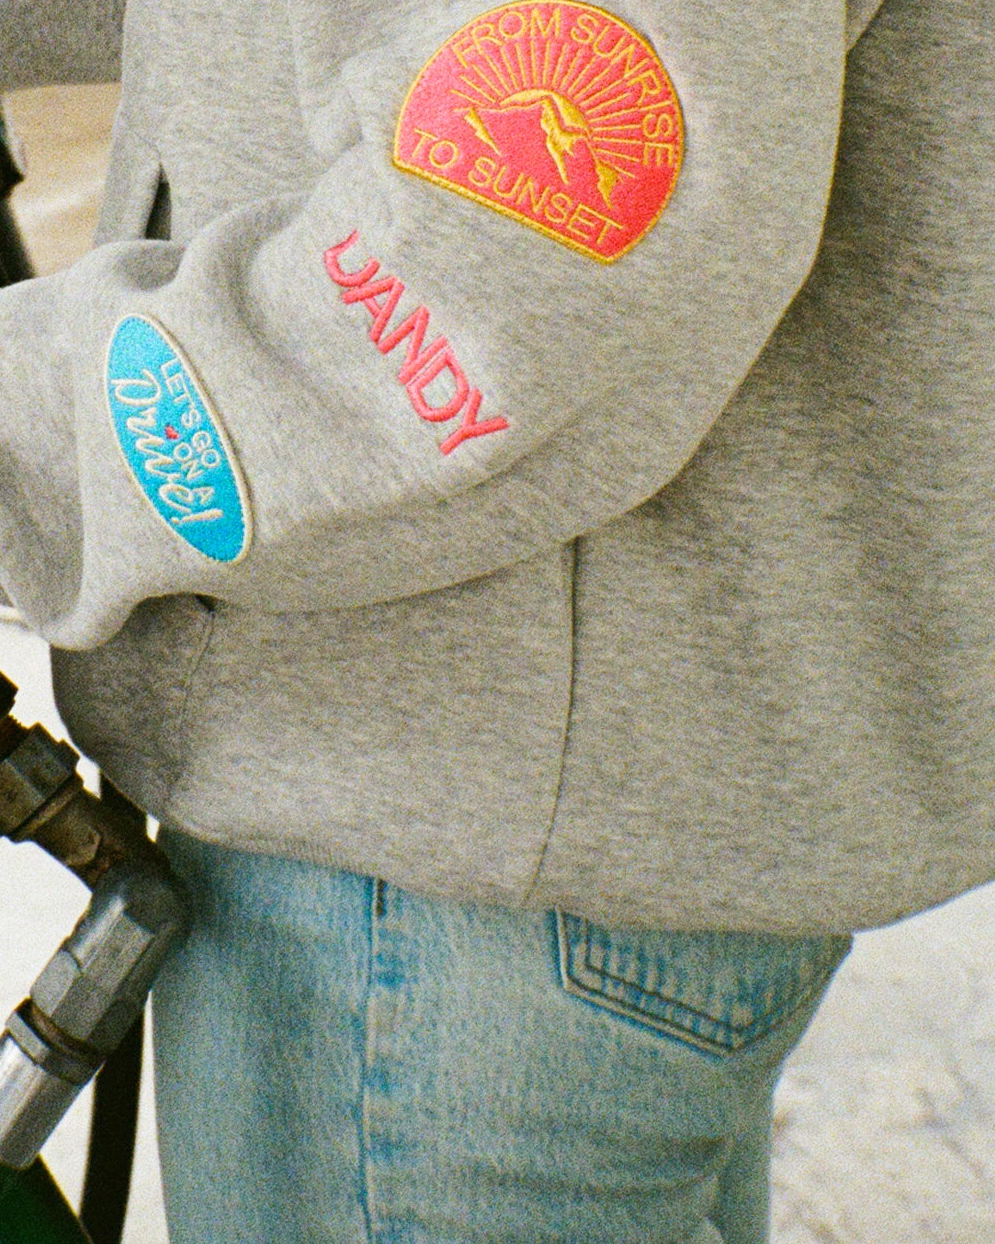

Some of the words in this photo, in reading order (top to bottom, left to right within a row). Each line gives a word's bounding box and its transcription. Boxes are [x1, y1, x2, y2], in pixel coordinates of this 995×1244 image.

[453, 7, 561, 69] FROM
[570, 12, 676, 167] SUNRISE
[408, 128, 459, 169] TO
[467, 157, 624, 245] SUNSET
[111, 368, 224, 524] Drive!
[160, 357, 201, 428] LET'S
[192, 430, 221, 468] GO
[173, 442, 204, 481] ON
[190, 486, 215, 505] A
